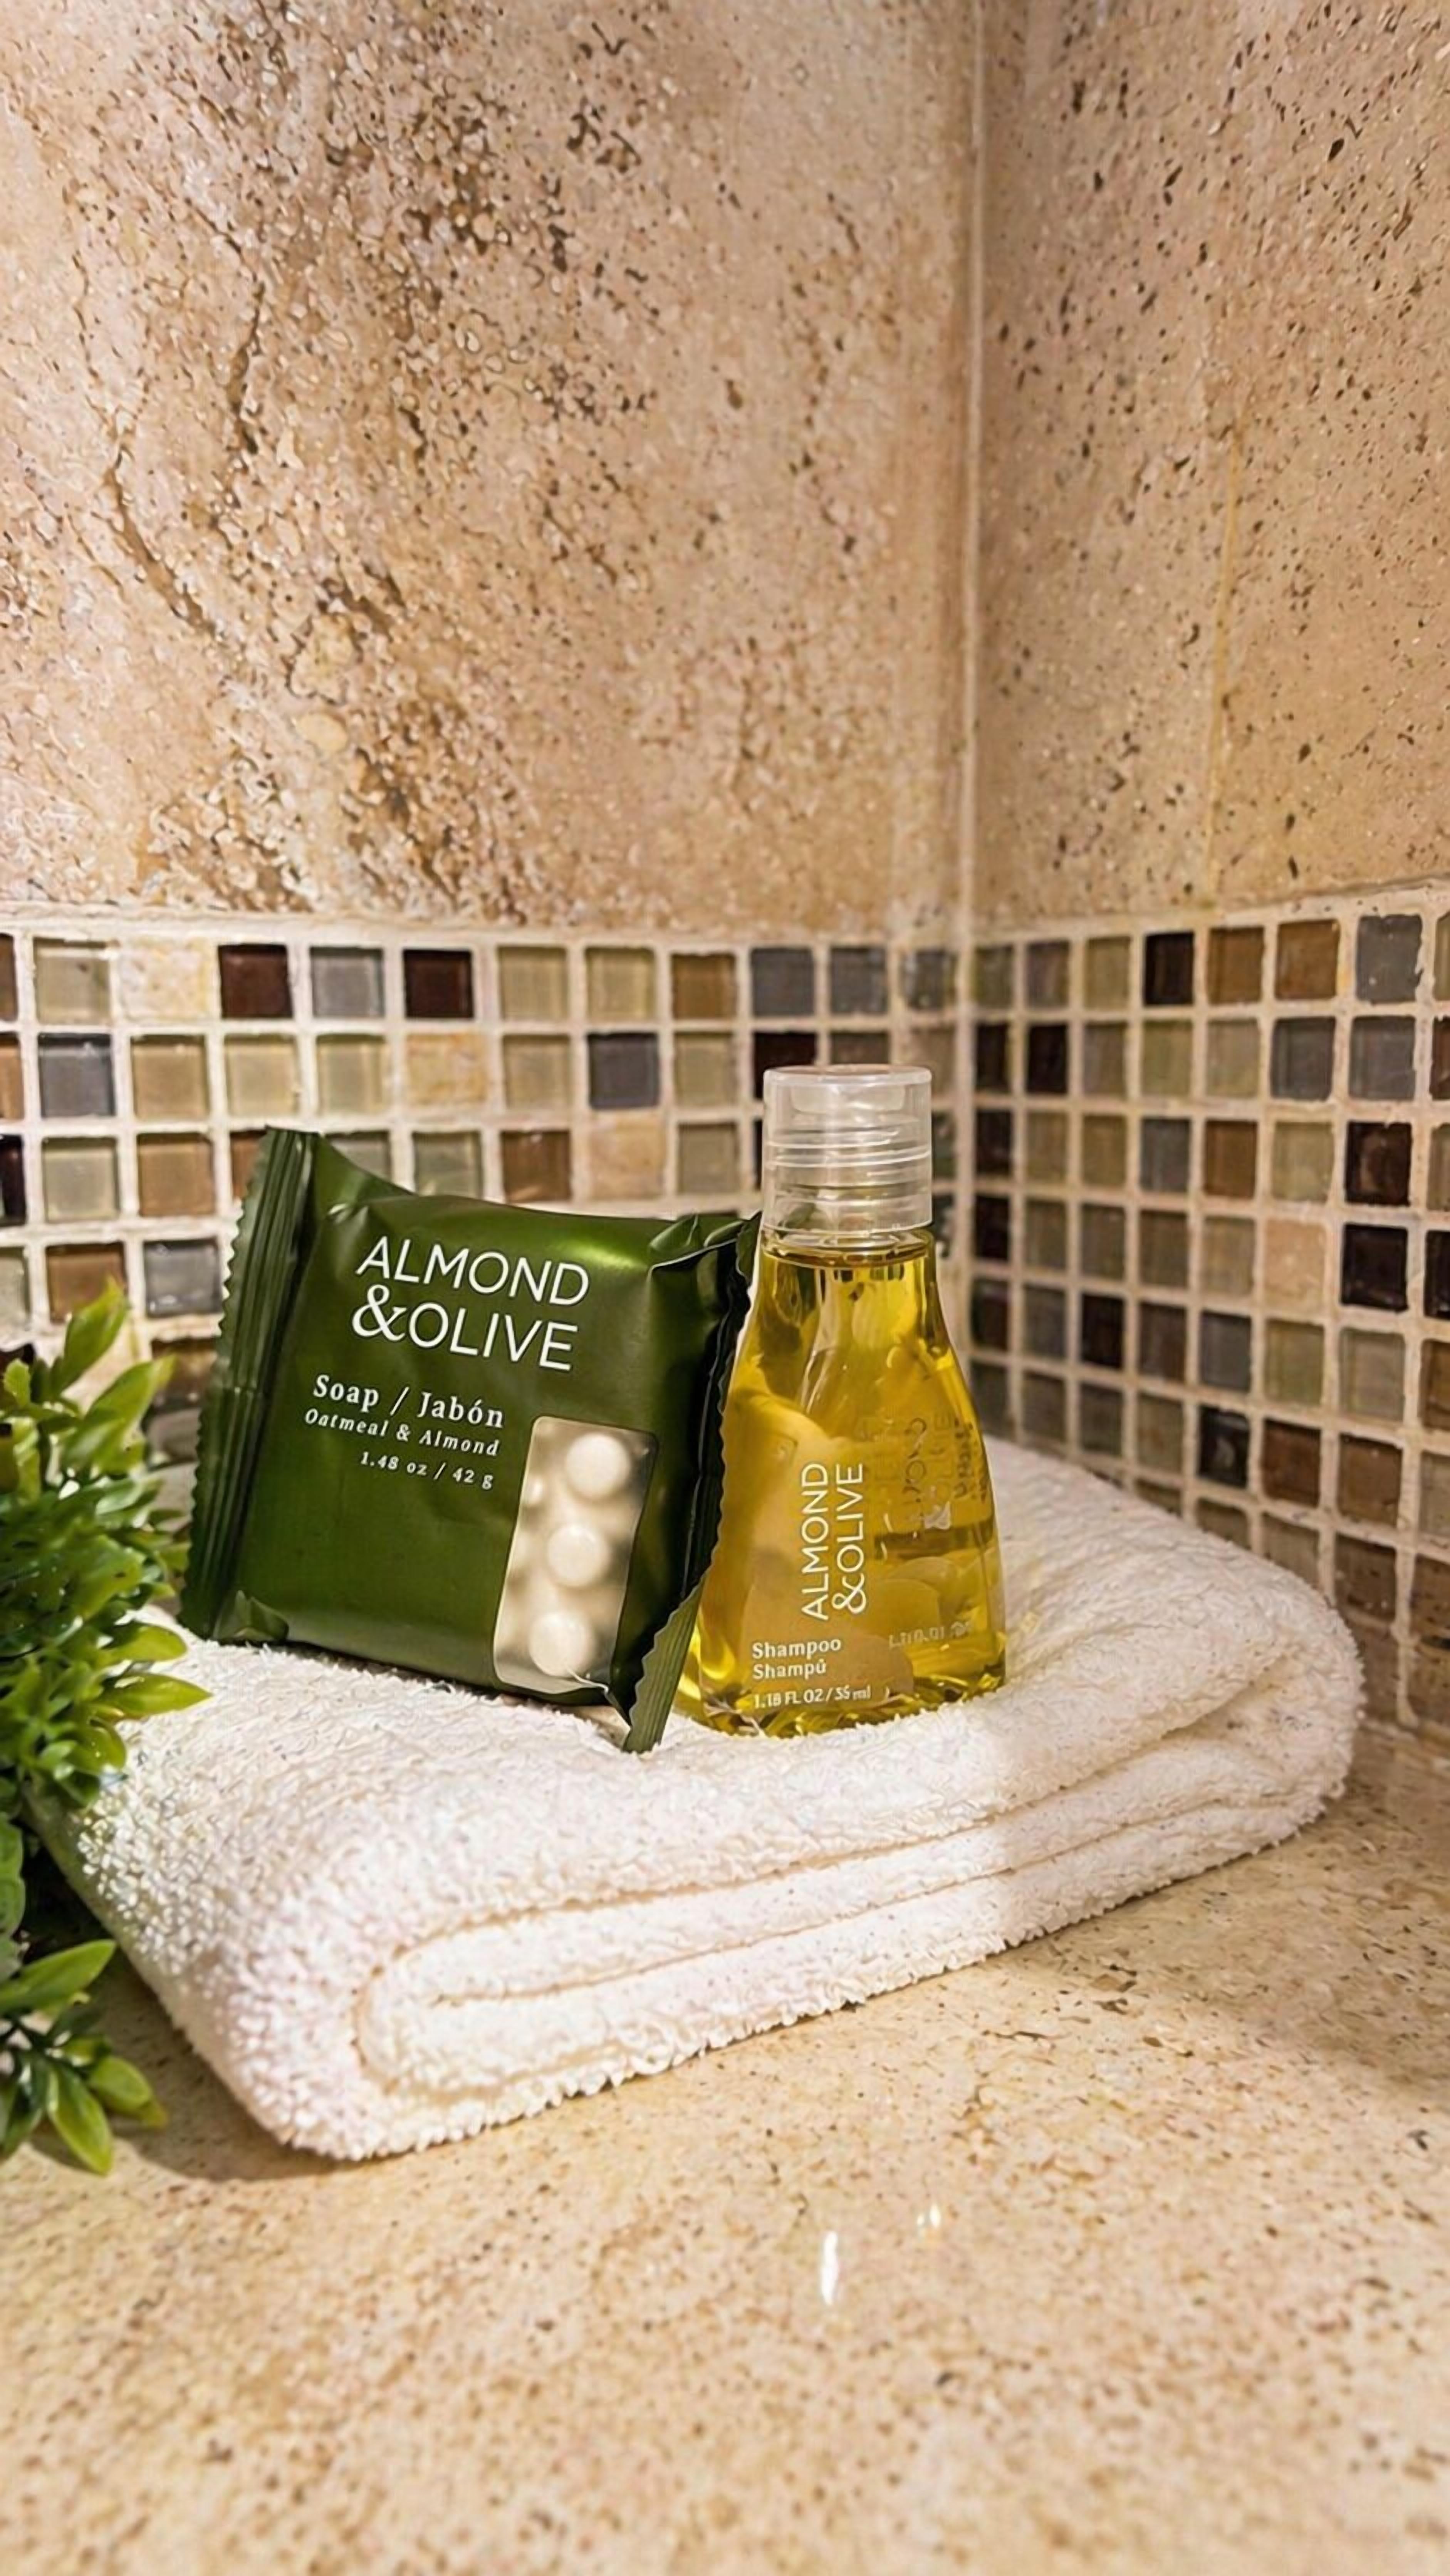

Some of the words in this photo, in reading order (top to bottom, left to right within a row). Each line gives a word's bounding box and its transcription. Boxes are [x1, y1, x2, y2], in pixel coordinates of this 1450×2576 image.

[355, 1235, 589, 1306] ALMOND
[351, 1283, 579, 1371] &OLIVE
[313, 1374, 379, 1413] Soap
[390, 1387, 409, 1416] /
[417, 1391, 504, 1429] Jabón
[305, 1409, 389, 1437] Oatmeal
[396, 1424, 411, 1442] &
[419, 1429, 500, 1457] Almond
[361, 1451, 399, 1470] 1.48
[406, 1462, 427, 1476] oz
[434, 1463, 446, 1480] /
[453, 1467, 475, 1483] 42
[482, 1474, 493, 1490] g
[801, 1464, 829, 1621] ALMOND
[832, 1463, 866, 1614] &OLIVE
[752, 1639, 841, 1660] Shampoo
[753, 1658, 826, 1680] Shampú
[785, 1691, 801, 1705] FL
[853, 1684, 871, 1701] ml
